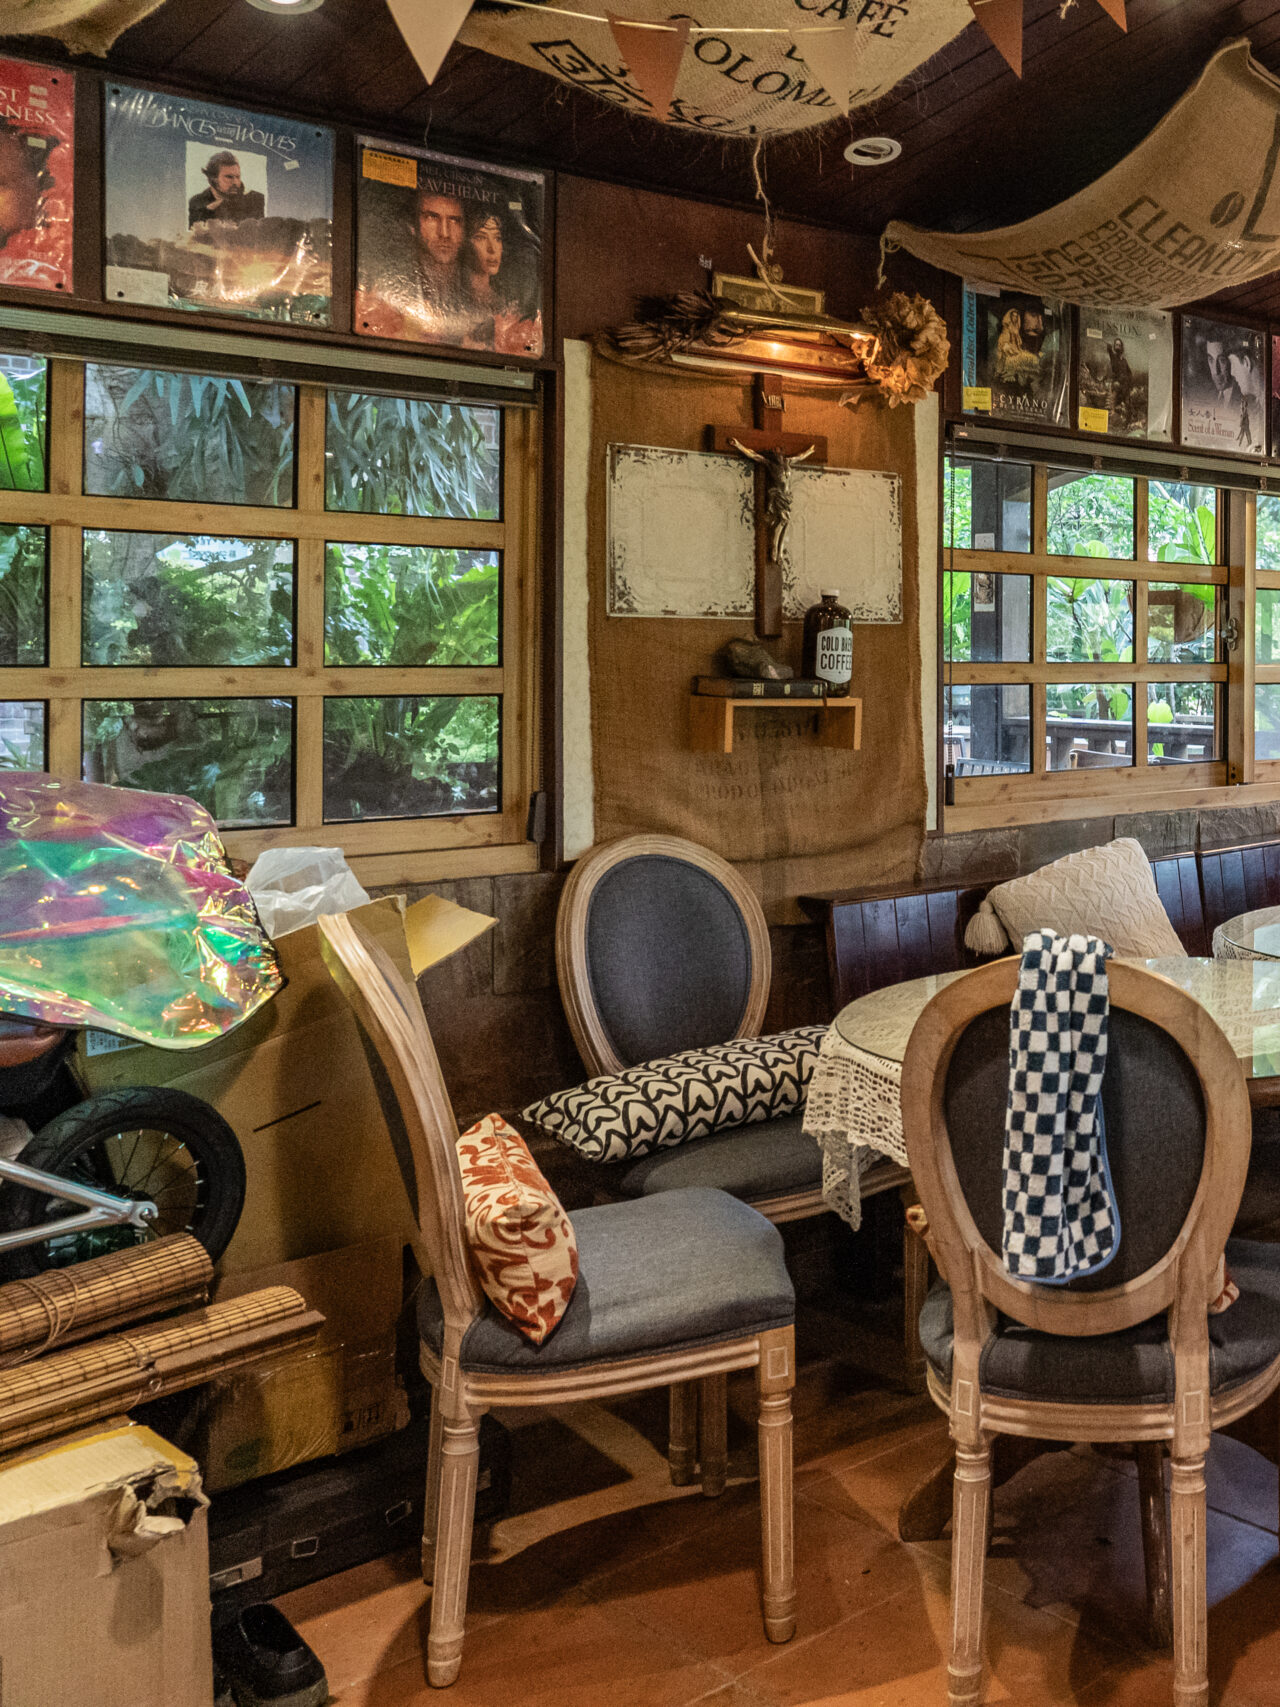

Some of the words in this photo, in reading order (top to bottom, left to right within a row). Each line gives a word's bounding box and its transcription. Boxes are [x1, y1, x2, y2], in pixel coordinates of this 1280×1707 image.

[225, 121, 297, 151] WOLVES
[417, 177, 499, 204] RAVEHEART
[1118, 195, 1226, 276] CLEAN
[1000, 393, 1049, 409] CYRANO
[821, 635, 840, 652] COLD
